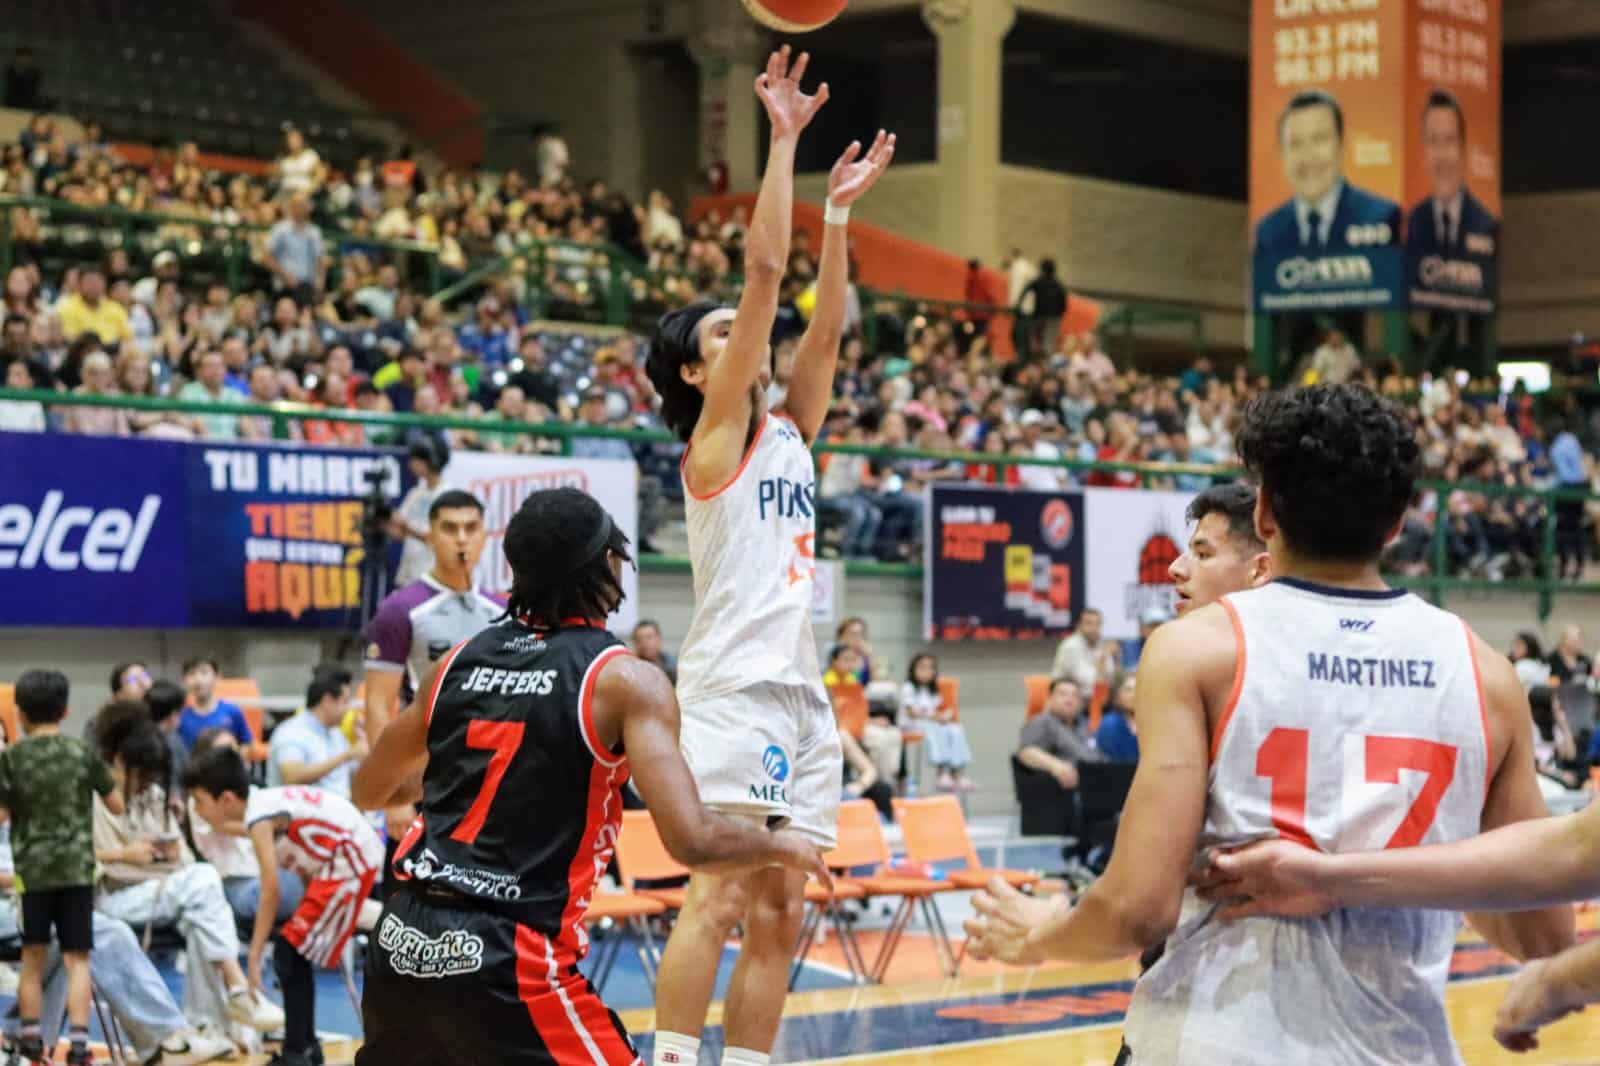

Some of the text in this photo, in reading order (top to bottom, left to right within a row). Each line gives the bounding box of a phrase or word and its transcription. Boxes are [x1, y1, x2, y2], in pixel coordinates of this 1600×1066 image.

[1336, 20, 1379, 49] FM
[1336, 50, 1379, 80] FM
[204, 450, 259, 492] TU
[0, 489, 162, 573] elcel
[244, 501, 365, 546] TIENE
[461, 666, 559, 696] JEFFERS
[1307, 652, 1437, 689] MARTINEZ
[450, 719, 527, 845] 7
[1255, 725, 1459, 854] 17
[380, 917, 478, 961] El Florido
